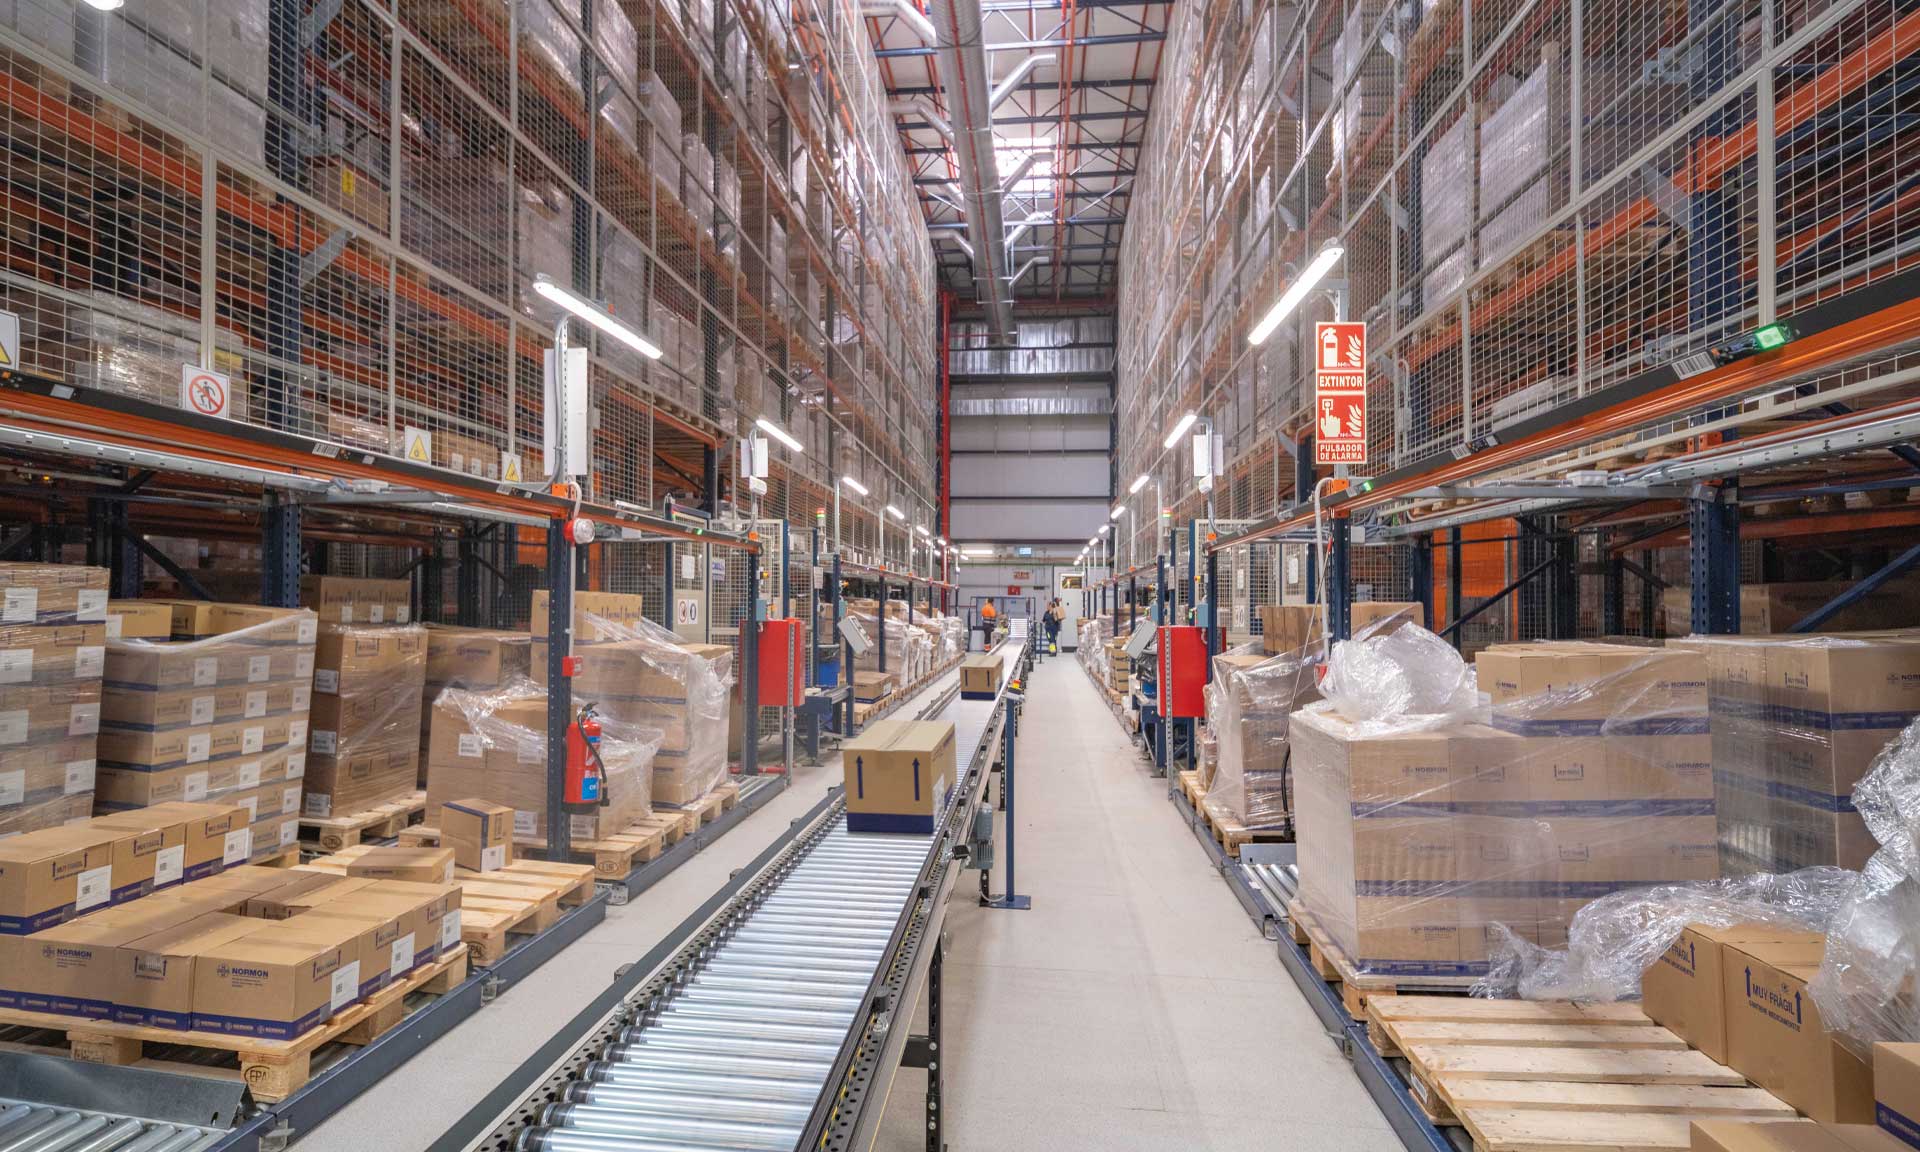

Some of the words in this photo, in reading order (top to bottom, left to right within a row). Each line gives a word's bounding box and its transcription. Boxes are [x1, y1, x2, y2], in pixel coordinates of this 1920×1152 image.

[1319, 375, 1363, 387] EXTINTOR
[1320, 444, 1362, 452] PULSADOR
[1320, 452, 1330, 460] DE
[1331, 452, 1363, 460] ALARMA
[56, 948, 92, 959] NORMON
[231, 967, 269, 977] NORMON
[1752, 983, 1768, 1001] MUY
